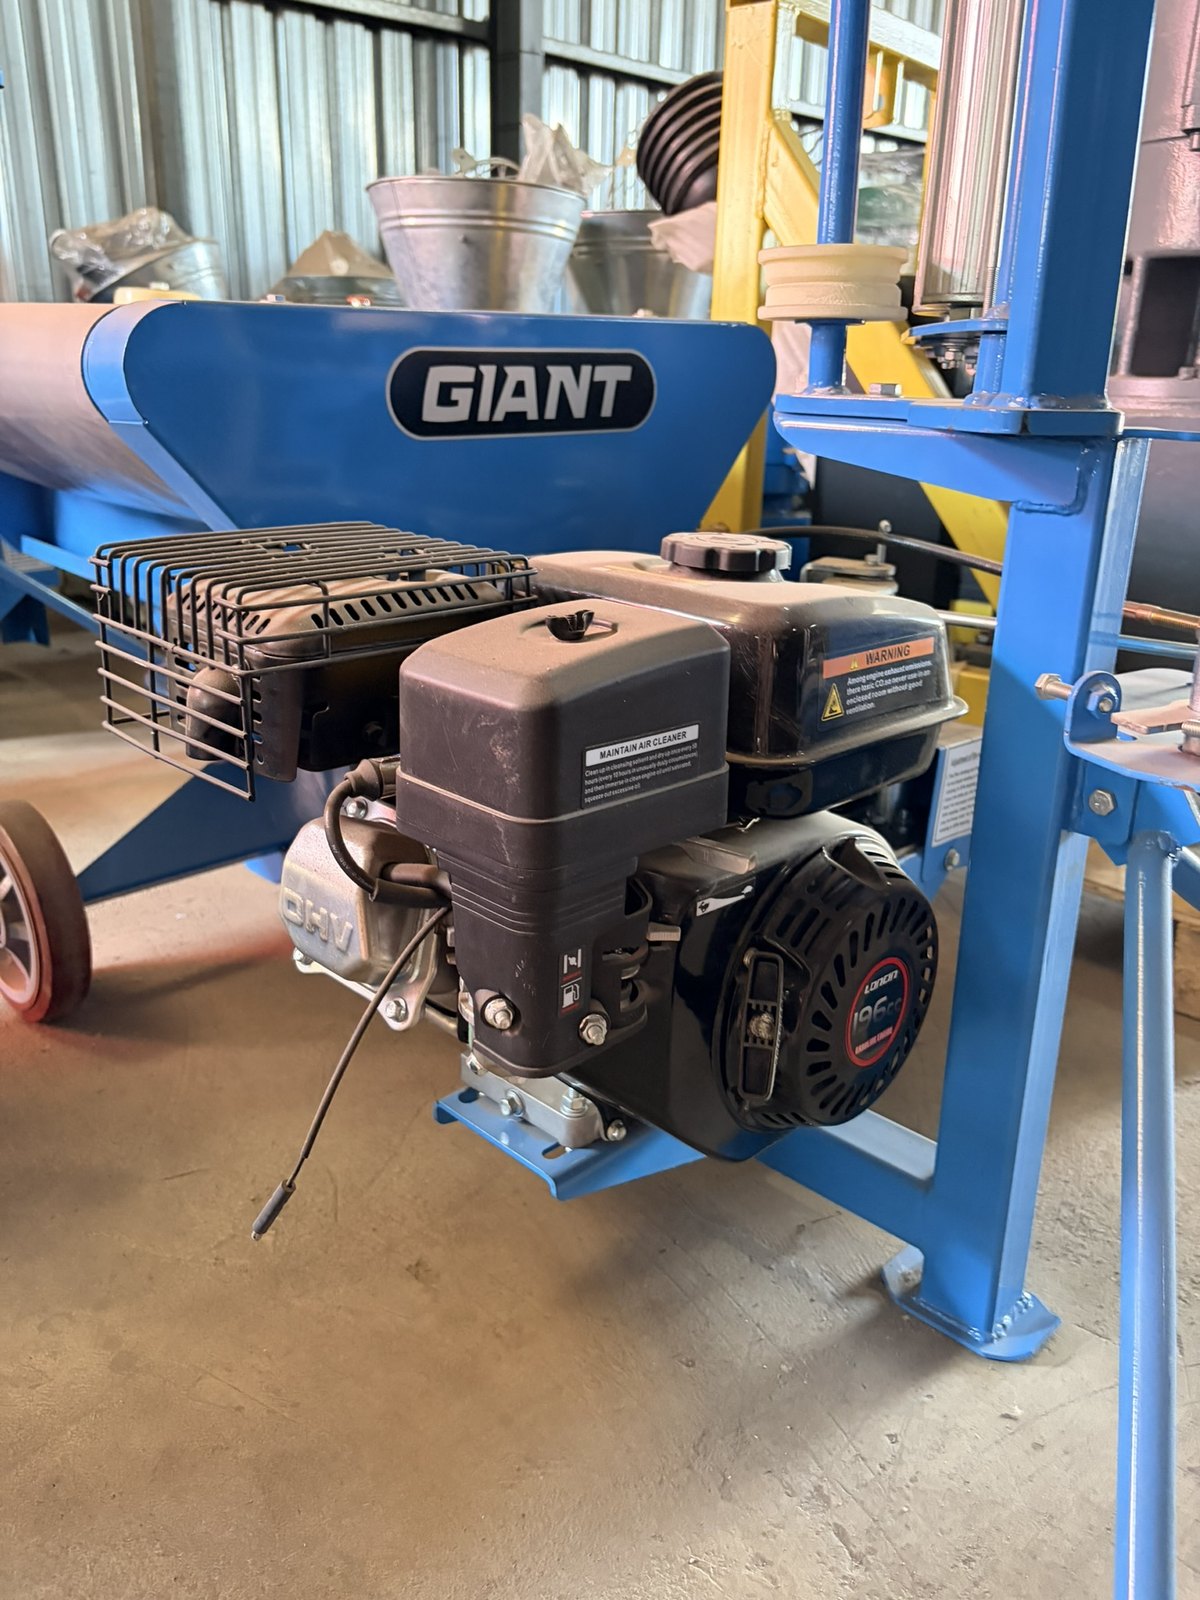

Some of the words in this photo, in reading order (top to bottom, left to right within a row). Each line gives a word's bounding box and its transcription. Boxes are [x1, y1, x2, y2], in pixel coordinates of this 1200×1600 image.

[422, 364, 632, 422] GIANT
[866, 645, 910, 665] WARNING
[847, 676, 865, 686] Among
[866, 670, 883, 682] engine
[884, 665, 904, 676] exhaust
[847, 686, 860, 695] there
[891, 674, 906, 684] never
[906, 671, 917, 680] use
[846, 693, 871, 705] enclosed
[871, 689, 886, 698] room
[887, 682, 907, 695] without
[908, 678, 922, 691] good
[600, 743, 637, 759] MAINTAIN
[638, 739, 652, 751] AIR
[652, 731, 687, 748] CLEANER
[584, 768, 598, 777] Clean
[599, 766, 605, 774] up
[610, 759, 631, 772] cleansing
[632, 755, 648, 765] solvent
[618, 768, 631, 777] hours
[636, 761, 655, 773] unusually
[656, 758, 667, 768] dusty
[584, 786, 593, 795] and
[593, 783, 604, 792] then
[604, 778, 623, 789] immerse
[629, 773, 641, 782] clean
[641, 770, 655, 781] engine
[584, 793, 603, 803] squeeze
[603, 790, 611, 798] out
[612, 784, 633, 795] excessive
[283, 887, 353, 952] OHV
[852, 996, 902, 1034] 196cc
